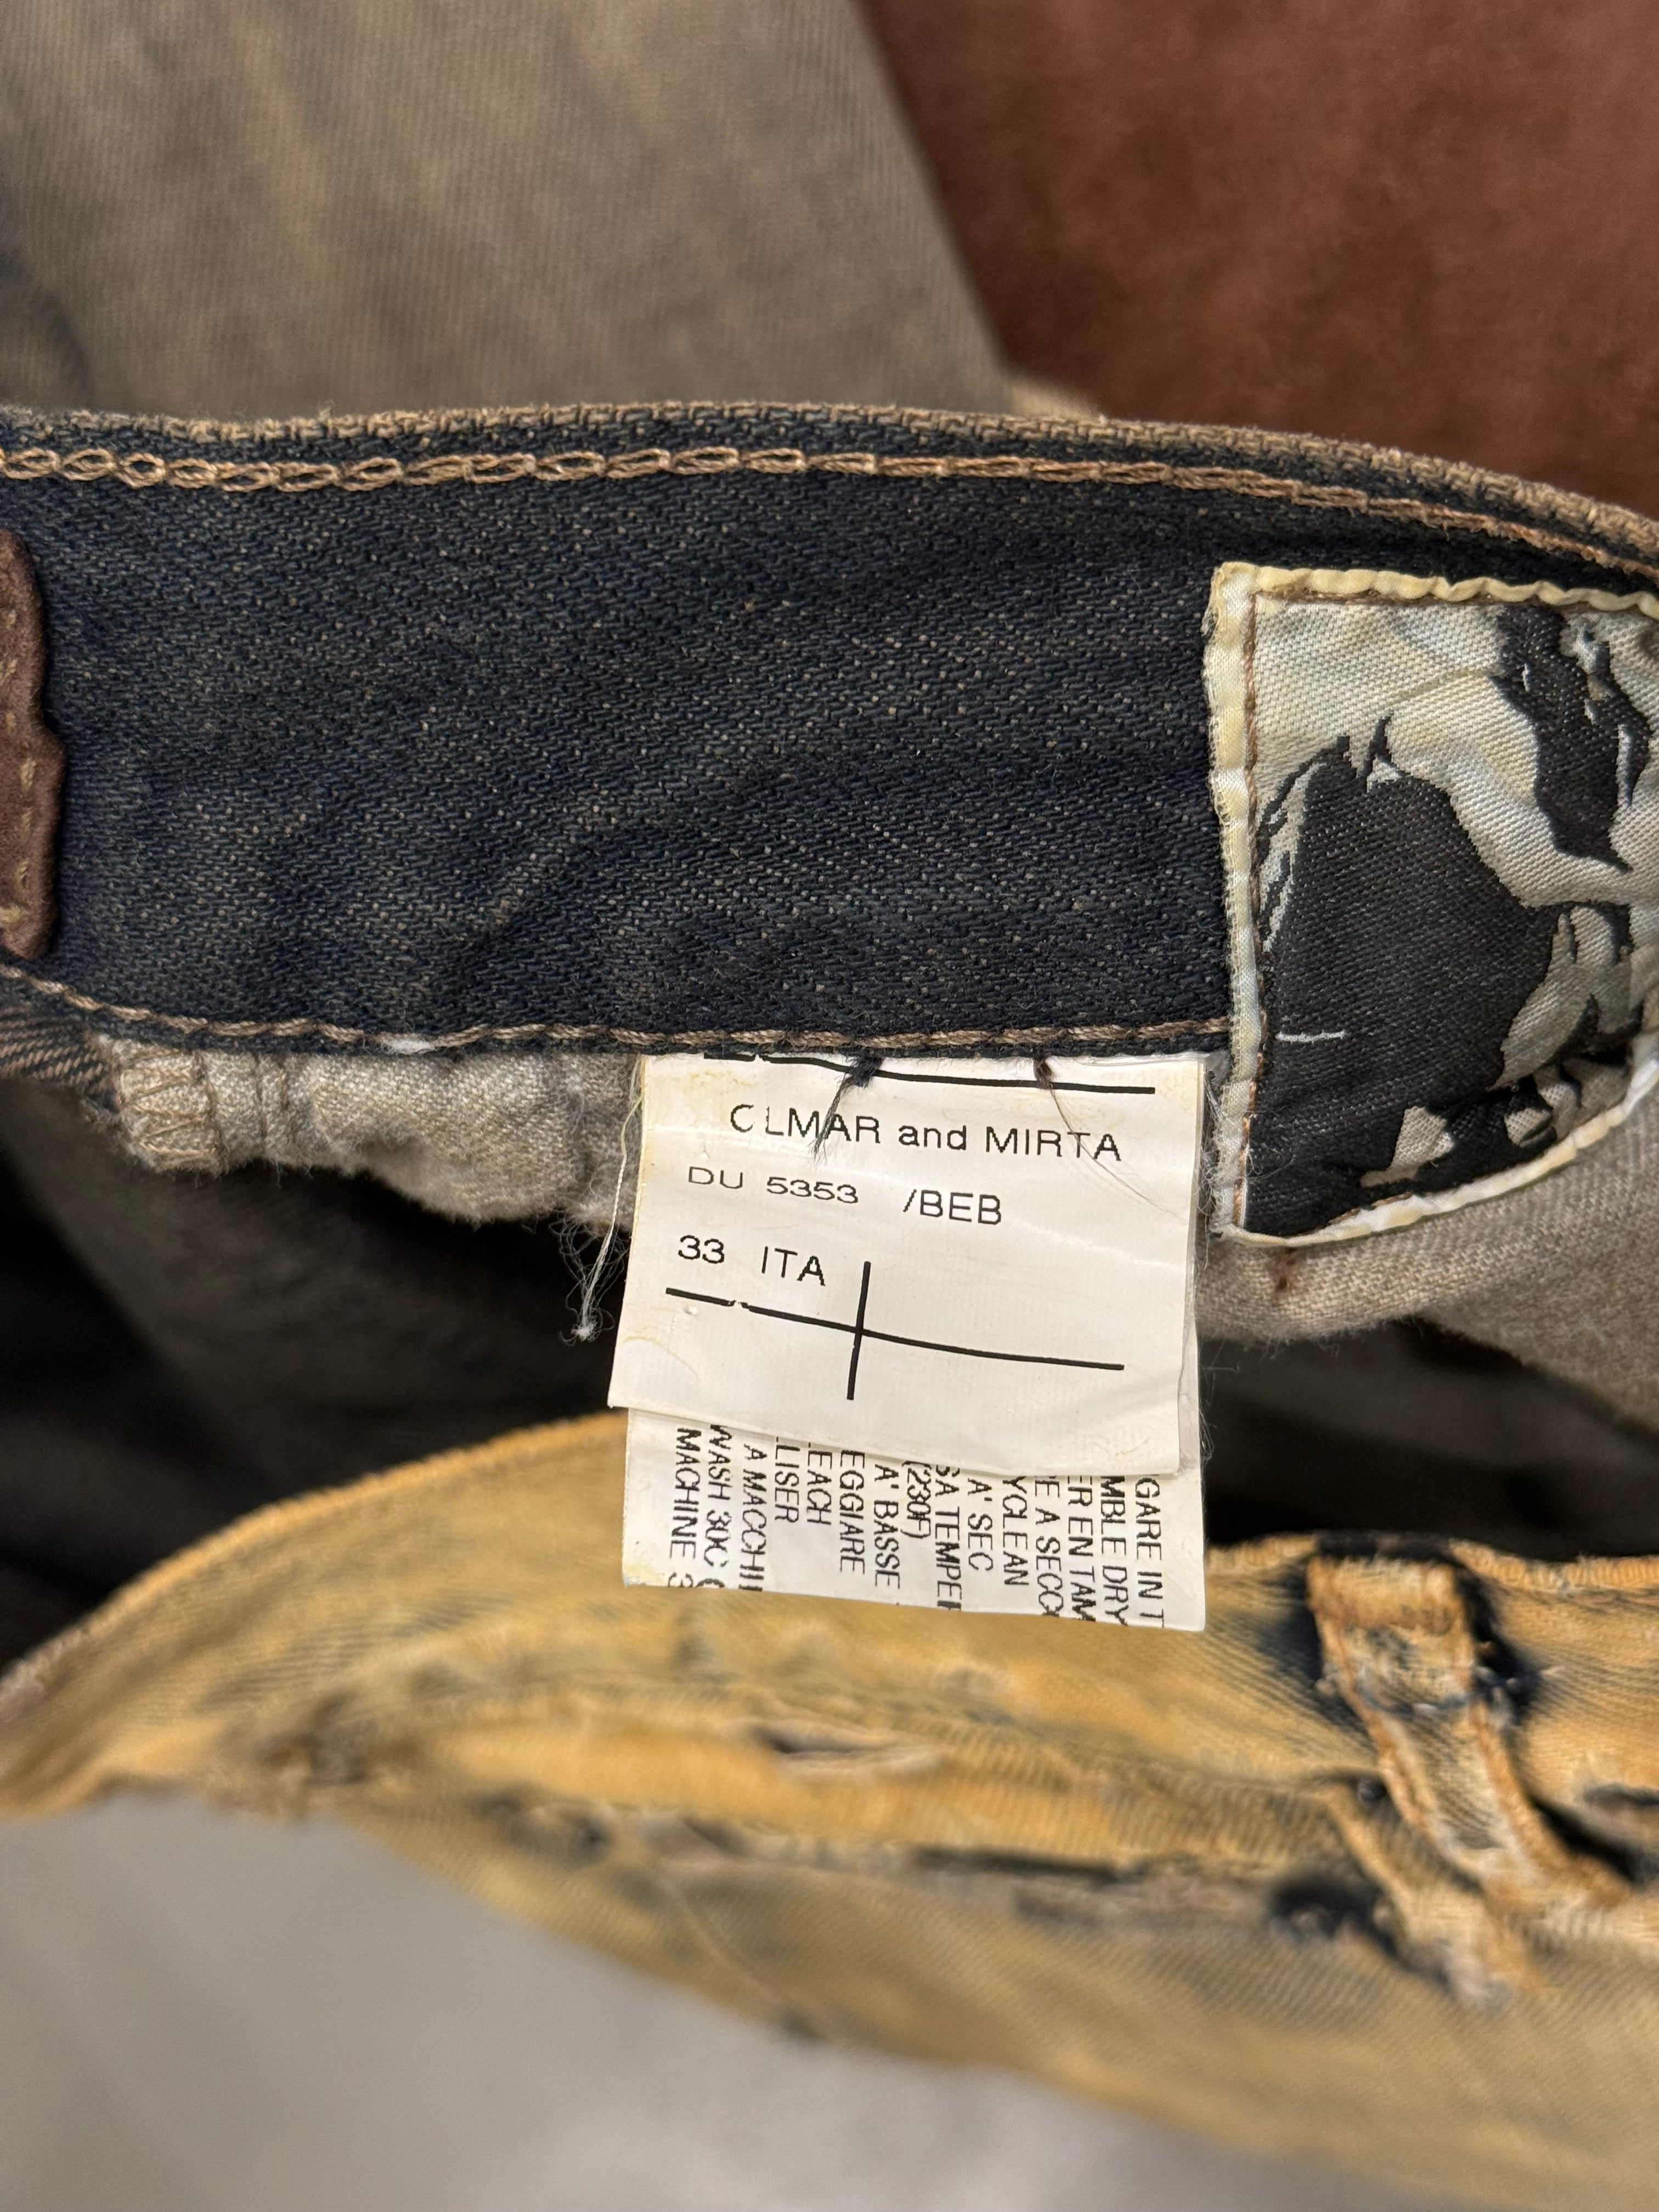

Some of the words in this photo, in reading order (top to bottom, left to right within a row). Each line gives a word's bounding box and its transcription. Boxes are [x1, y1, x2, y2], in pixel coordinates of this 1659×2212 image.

[898, 1125, 967, 1150] and
[986, 1126, 1121, 1161] MIRTA
[689, 1166, 743, 1189] DU
[767, 1176, 859, 1204] 5353
[902, 1189, 1002, 1225] /BEB
[678, 1235, 725, 1264] 33
[761, 1246, 826, 1286] ITA
[743, 1444, 768, 1460] A
[774, 1437, 800, 1523] LISER
[669, 1428, 702, 1559] MACHINE
[806, 1442, 832, 1525] EACH
[839, 1450, 865, 1575] EGGIARE
[901, 1461, 932, 1538] (230F)
[704, 1509, 732, 1568] 30C
[874, 1500, 901, 1589] BASSE
[968, 1513, 994, 1571] SEC
[1002, 1475, 1030, 1585] YCLEAN
[1035, 1508, 1060, 1525] A
[1068, 1517, 1094, 1556] EN
[1135, 1474, 1162, 1561] GARE
[1102, 1565, 1129, 1626] DRY
[1137, 1571, 1164, 1600] IN
